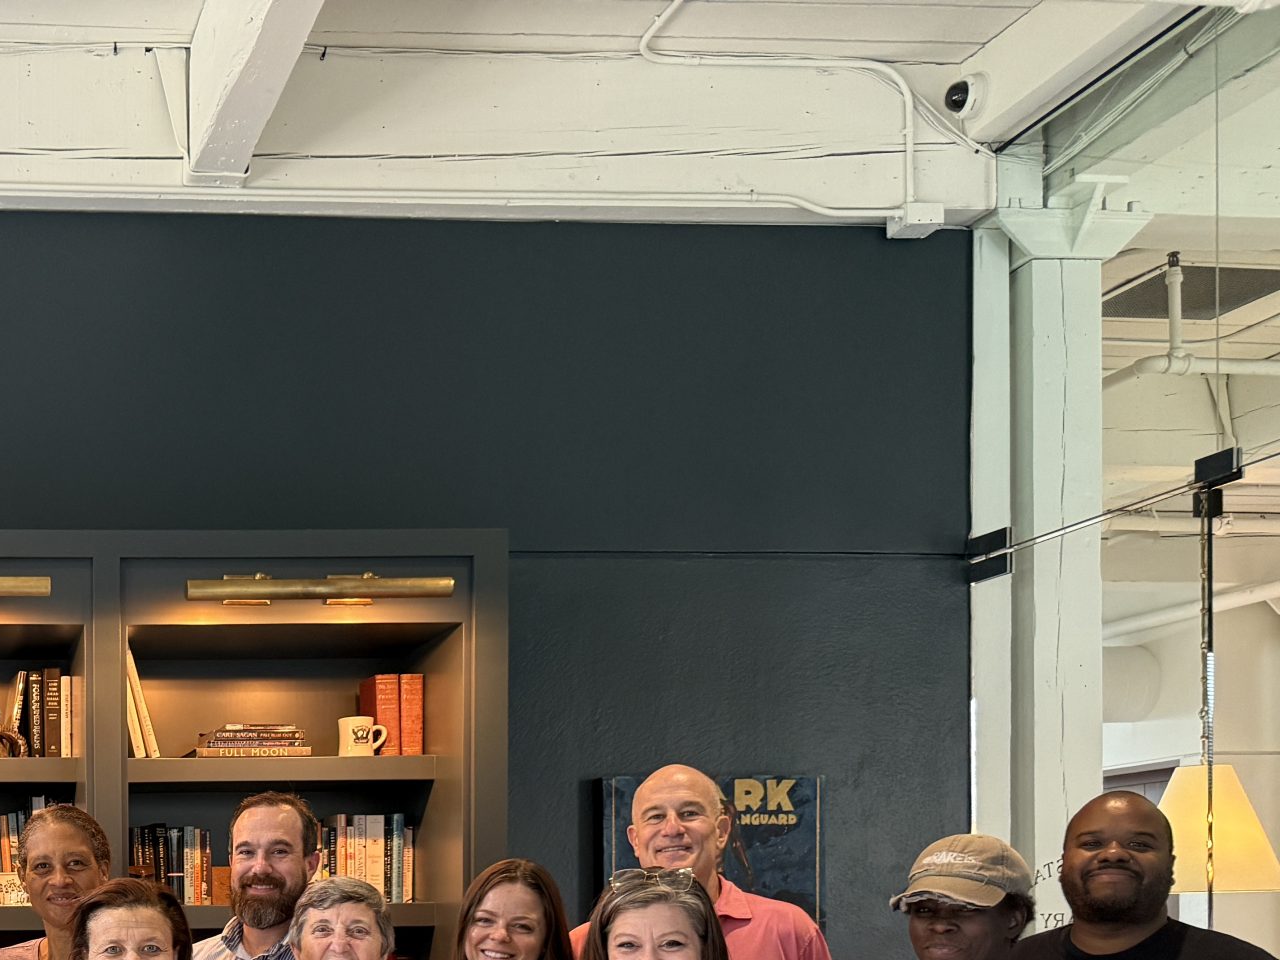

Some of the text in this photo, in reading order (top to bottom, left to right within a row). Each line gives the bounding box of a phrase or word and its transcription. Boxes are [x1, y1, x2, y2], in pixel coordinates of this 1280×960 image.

[219, 748, 288, 756] FULL MOON
[720, 778, 796, 811] RK
[735, 813, 797, 825] NGUARD
